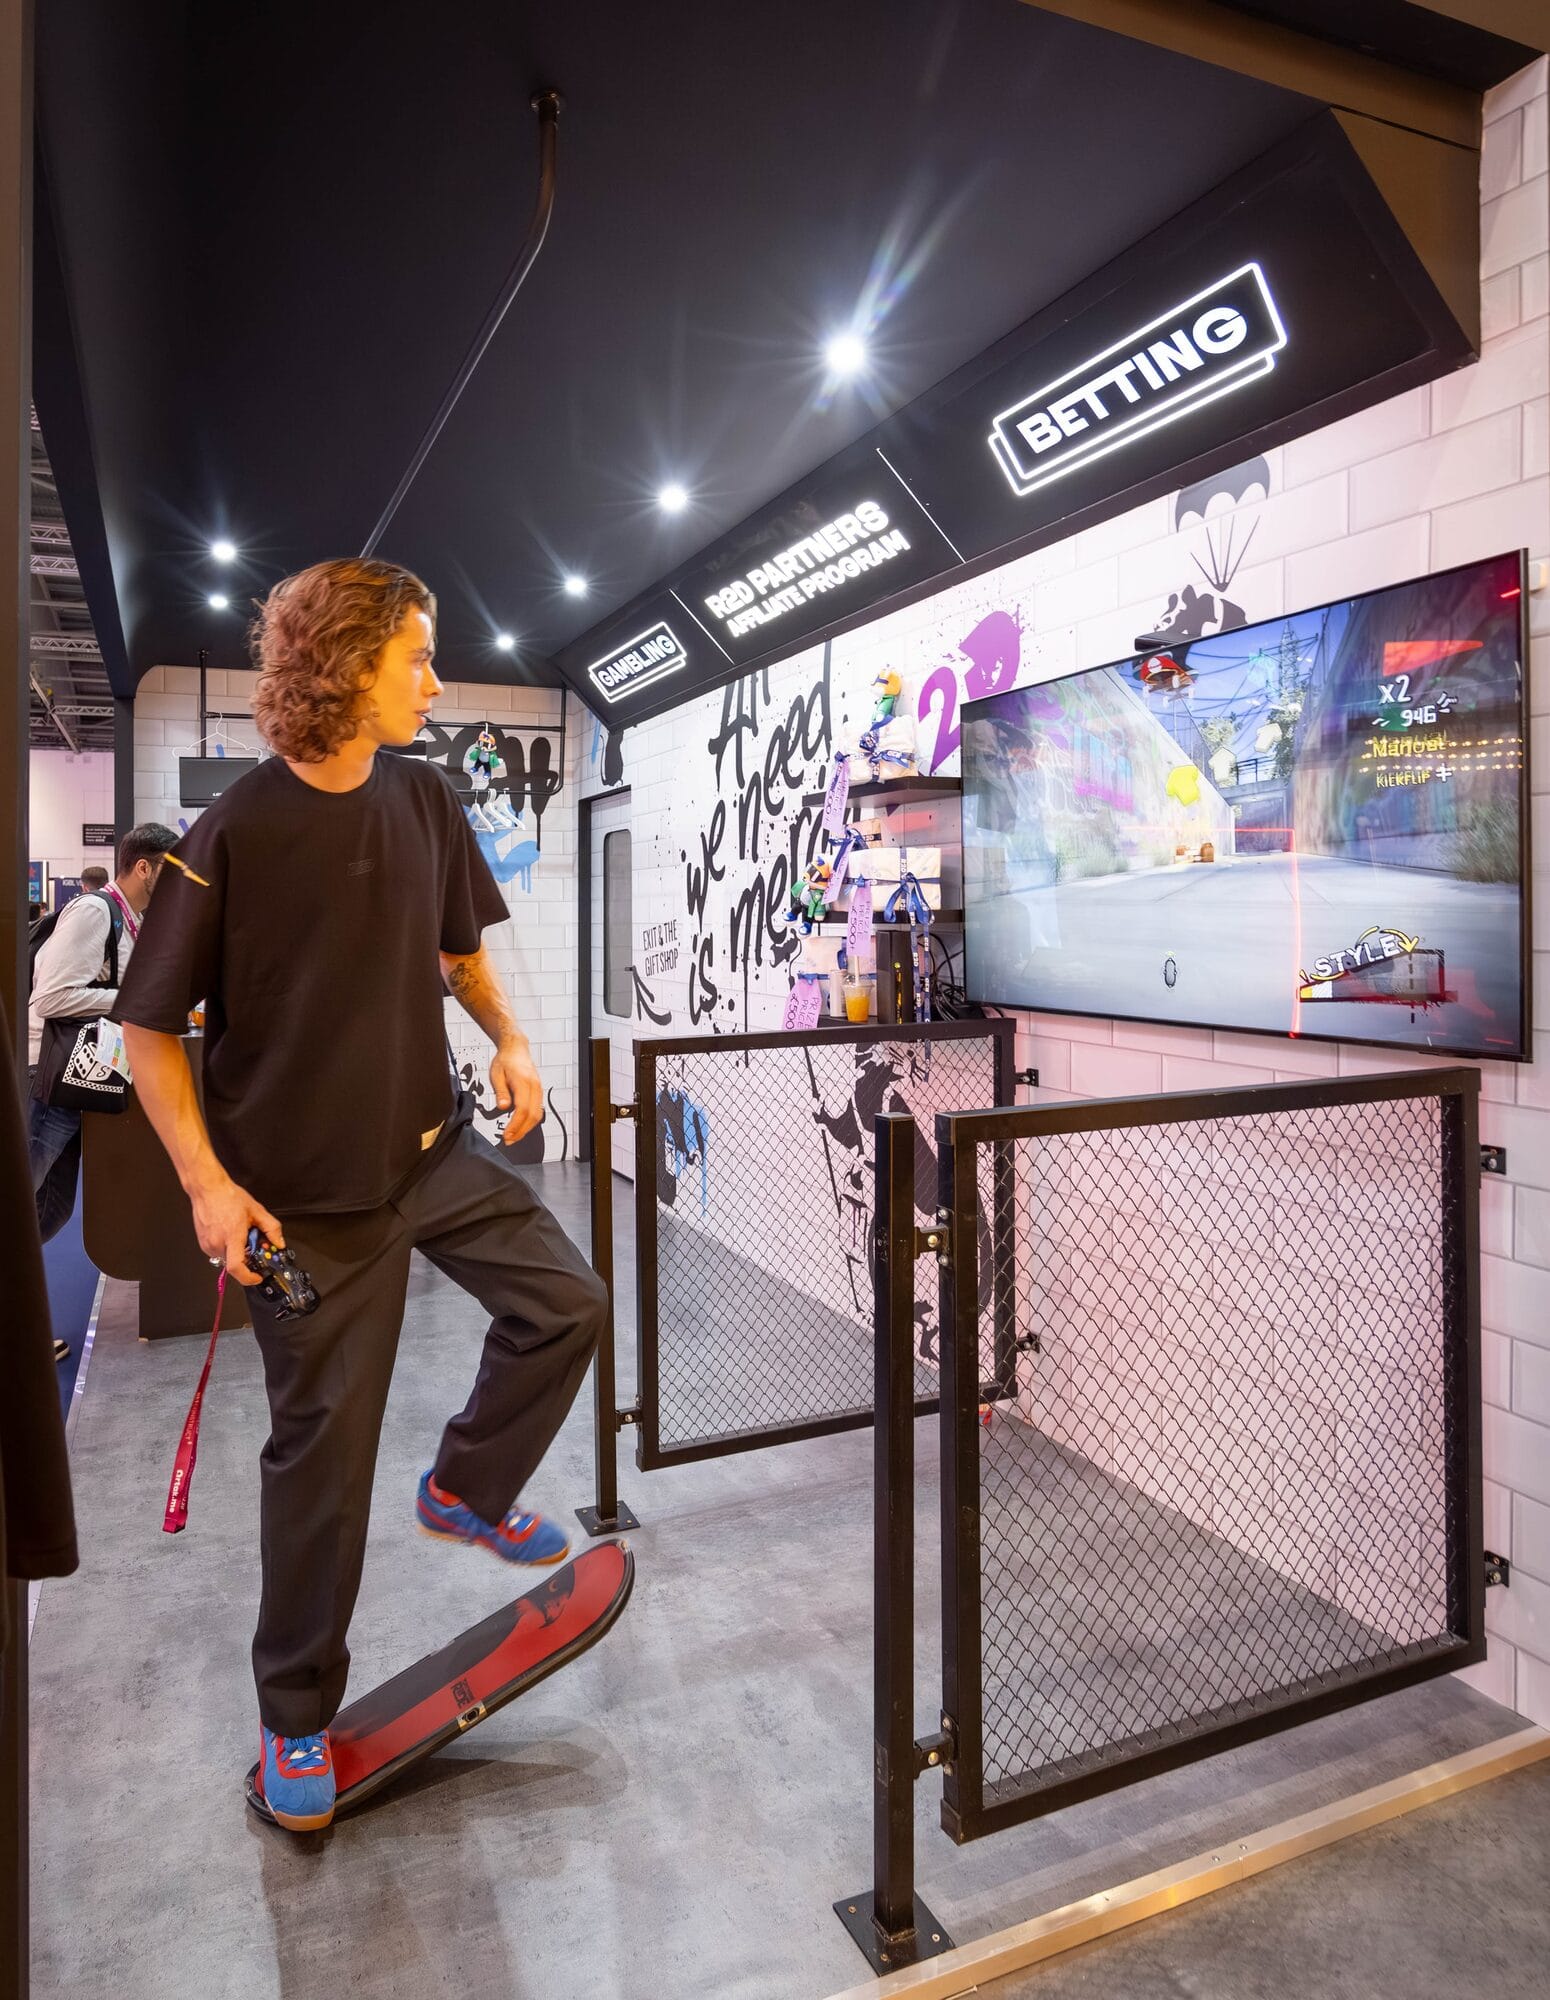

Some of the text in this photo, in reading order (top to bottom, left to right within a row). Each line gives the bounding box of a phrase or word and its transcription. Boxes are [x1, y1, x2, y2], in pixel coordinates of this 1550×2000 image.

[1016, 307, 1247, 454] BETTING
[746, 501, 889, 595] PARTNERS
[726, 529, 911, 638] AFFILIATE PROGRAM
[597, 634, 677, 687] GAMBLING
[643, 927, 657, 951] EXIT
[663, 919, 678, 943] THE
[1314, 934, 1400, 977] STYLE
[645, 948, 678, 977] GIFT SHOP
